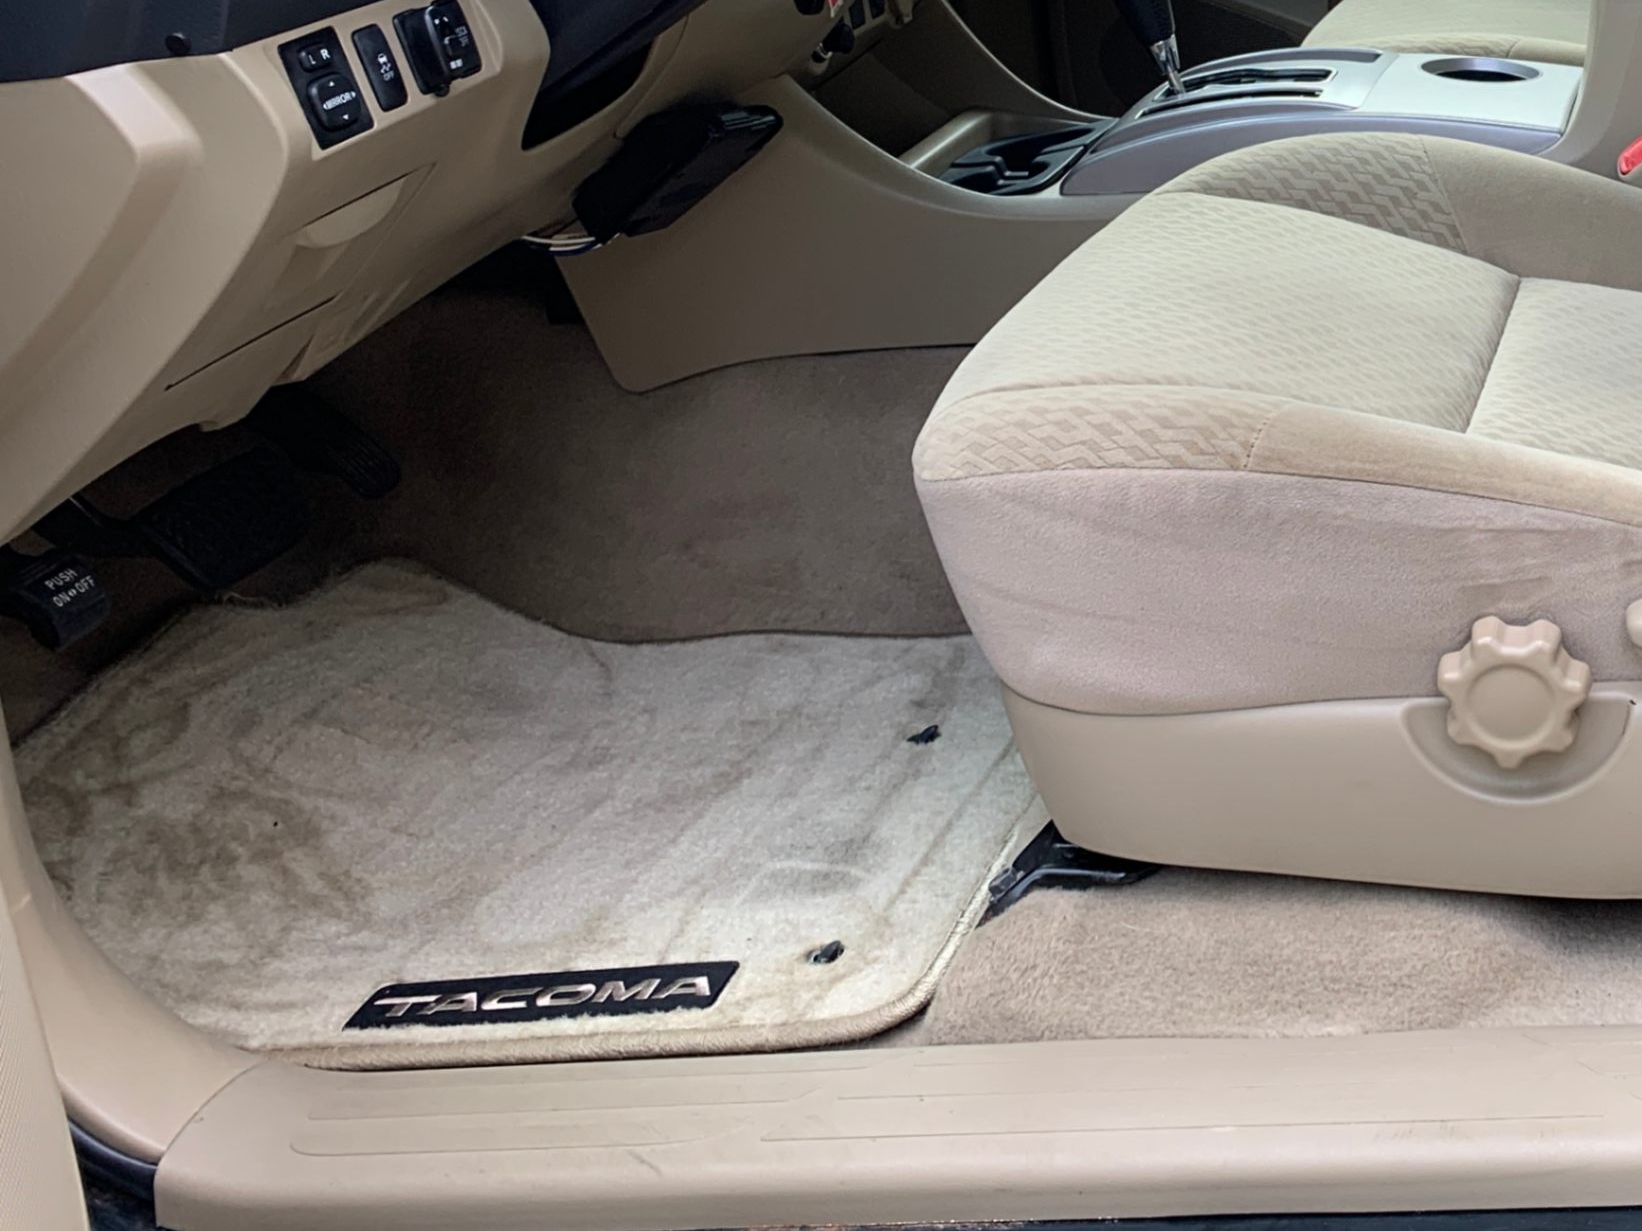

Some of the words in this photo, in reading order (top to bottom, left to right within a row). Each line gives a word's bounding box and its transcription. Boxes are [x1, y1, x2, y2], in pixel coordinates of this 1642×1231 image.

[309, 54, 317, 65] L
[320, 48, 331, 60] R
[44, 568, 78, 590] PUSH
[52, 591, 71, 607] ON
[74, 575, 95, 593] OFF
[373, 975, 711, 1018] TACOMA
